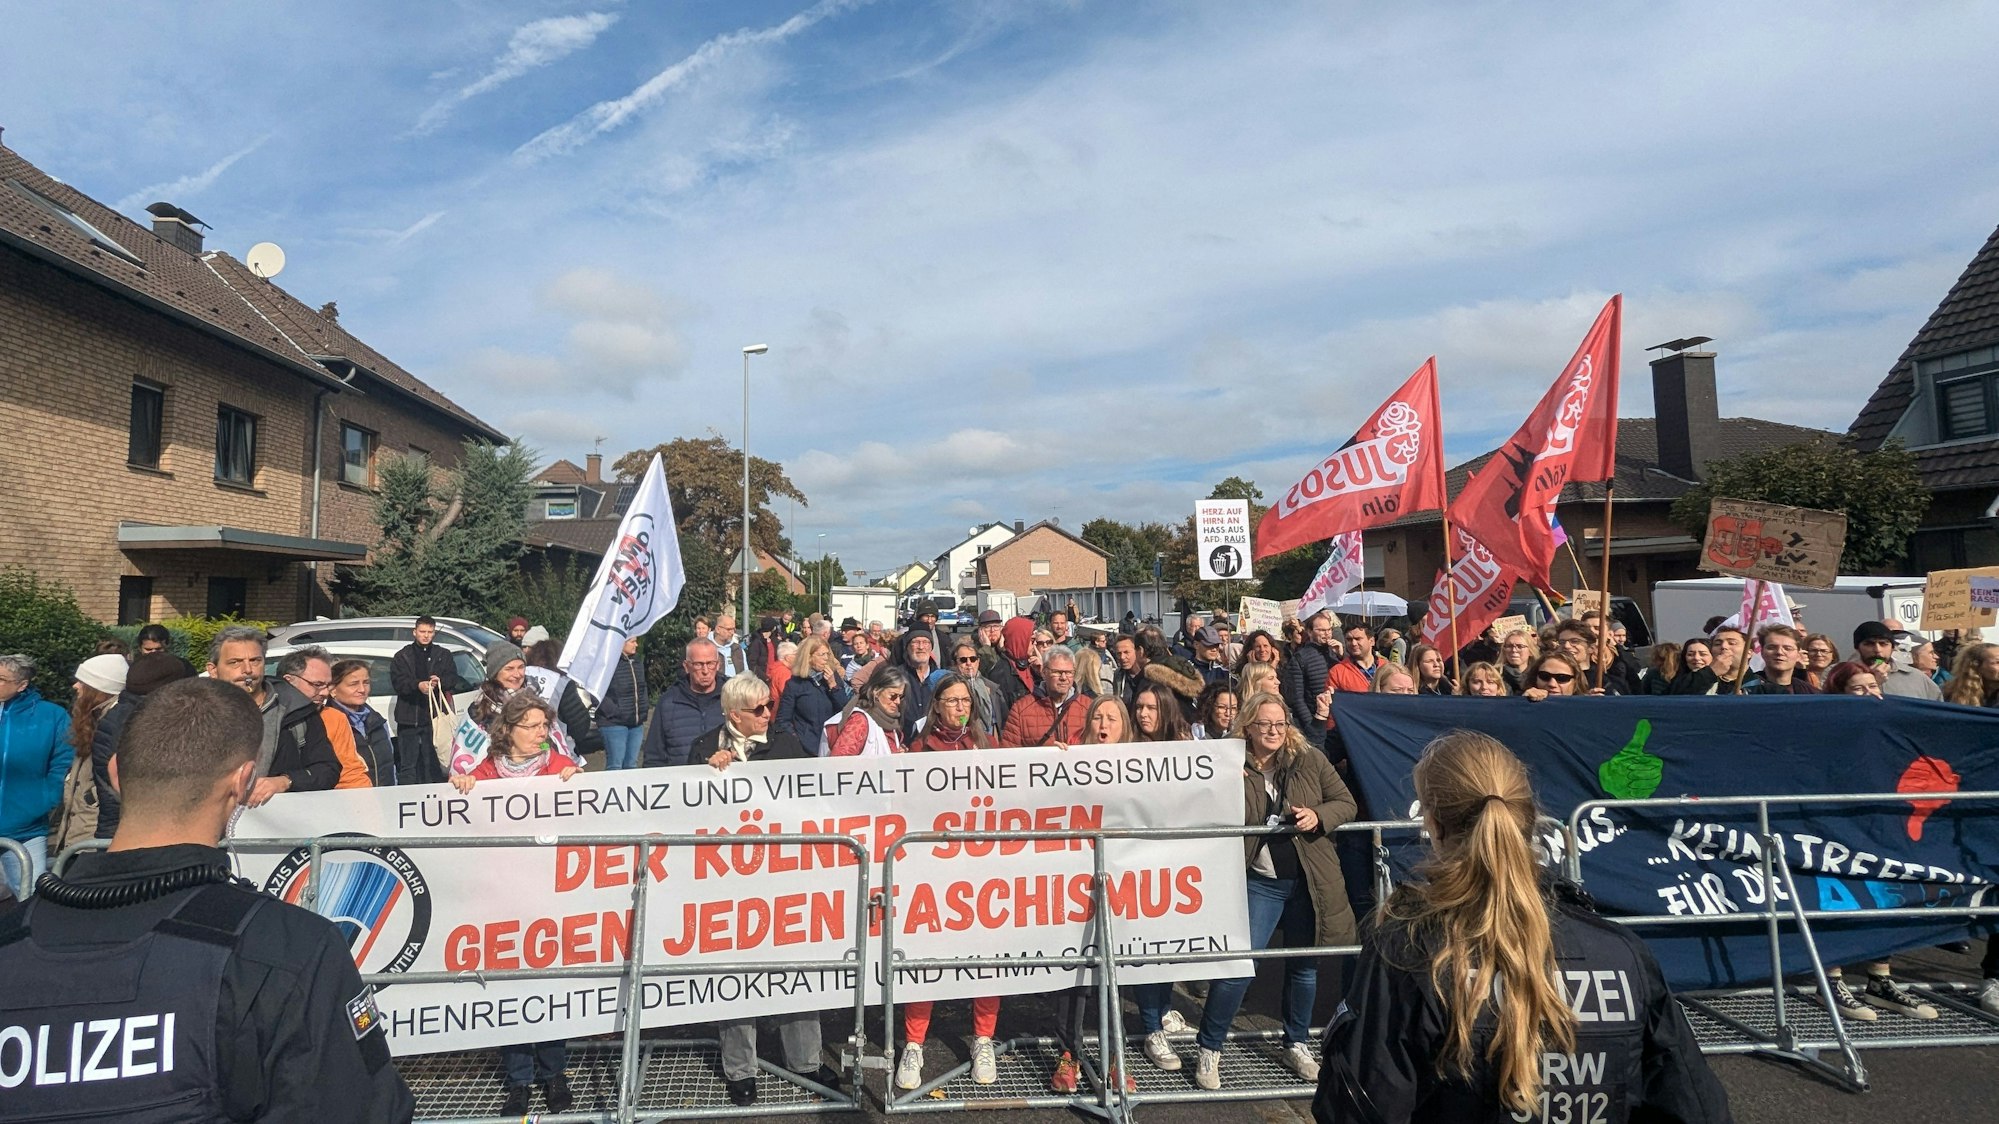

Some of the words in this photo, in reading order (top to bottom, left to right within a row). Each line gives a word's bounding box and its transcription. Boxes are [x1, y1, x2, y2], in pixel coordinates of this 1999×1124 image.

[1225, 535, 1246, 543] RAUS
[1901, 604, 1919, 619] 100
[399, 793, 471, 829] FÜR
[482, 783, 671, 823] TOLERANZ
[682, 777, 753, 808] UND
[763, 767, 915, 800] VIELFALT
[925, 763, 1017, 793] OHNE
[1028, 754, 1214, 788] RASSISMUS
[931, 795, 1103, 859] SÜDEN
[268, 866, 293, 897] AZIS
[386, 851, 425, 896] GEFAHR
[1657, 872, 1740, 916] FÜR
[444, 908, 636, 972] GEGEN
[663, 889, 845, 957] JEDEN
[385, 941, 422, 975] NTIFA
[1542, 1051, 1607, 1086] RW
